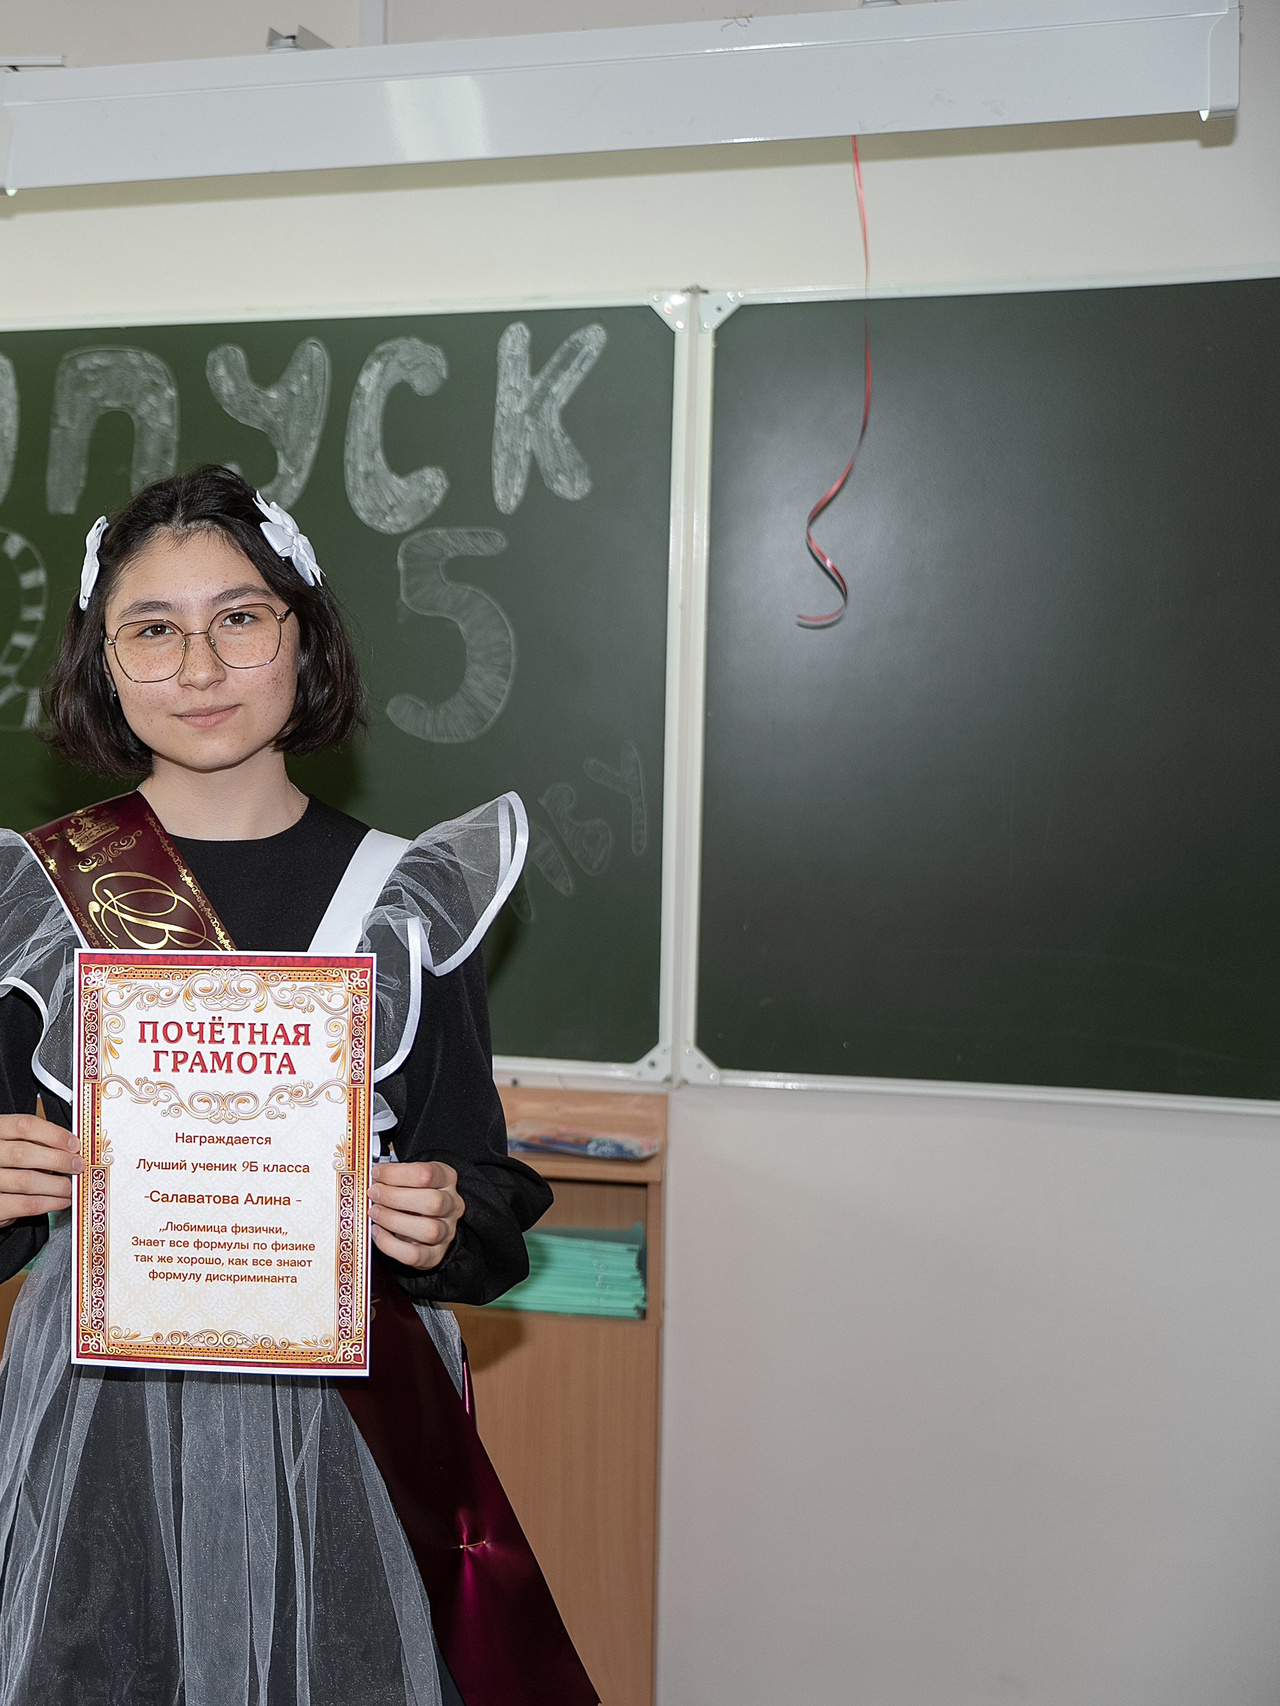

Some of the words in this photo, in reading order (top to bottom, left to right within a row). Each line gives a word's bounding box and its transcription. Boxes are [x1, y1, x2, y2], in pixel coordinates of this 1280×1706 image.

[138, 1016, 311, 1046] ПОЧЁТНАЯ
[153, 1050, 296, 1075] ГРАМОТА
[175, 1132, 272, 1146] Награждается
[136, 1158, 187, 1173] Лучший
[191, 1162, 237, 1174] ученик
[241, 1160, 259, 1172] 9Б
[263, 1163, 310, 1173] класса
[244, 1193, 291, 1206] Алина
[131, 1236, 166, 1248] Знает
[169, 1239, 189, 1248] все
[193, 1238, 249, 1252] формулы
[253, 1241, 267, 1250] по
[271, 1240, 316, 1252] физике
[134, 1253, 153, 1263] так
[157, 1255, 173, 1264] же
[176, 1255, 225, 1267] хорошо,
[228, 1256, 248, 1266] как
[252, 1257, 273, 1267] все
[276, 1258, 313, 1268] знают
[148, 1269, 202, 1283] формулу
[204, 1272, 298, 1285] дискриминанта
